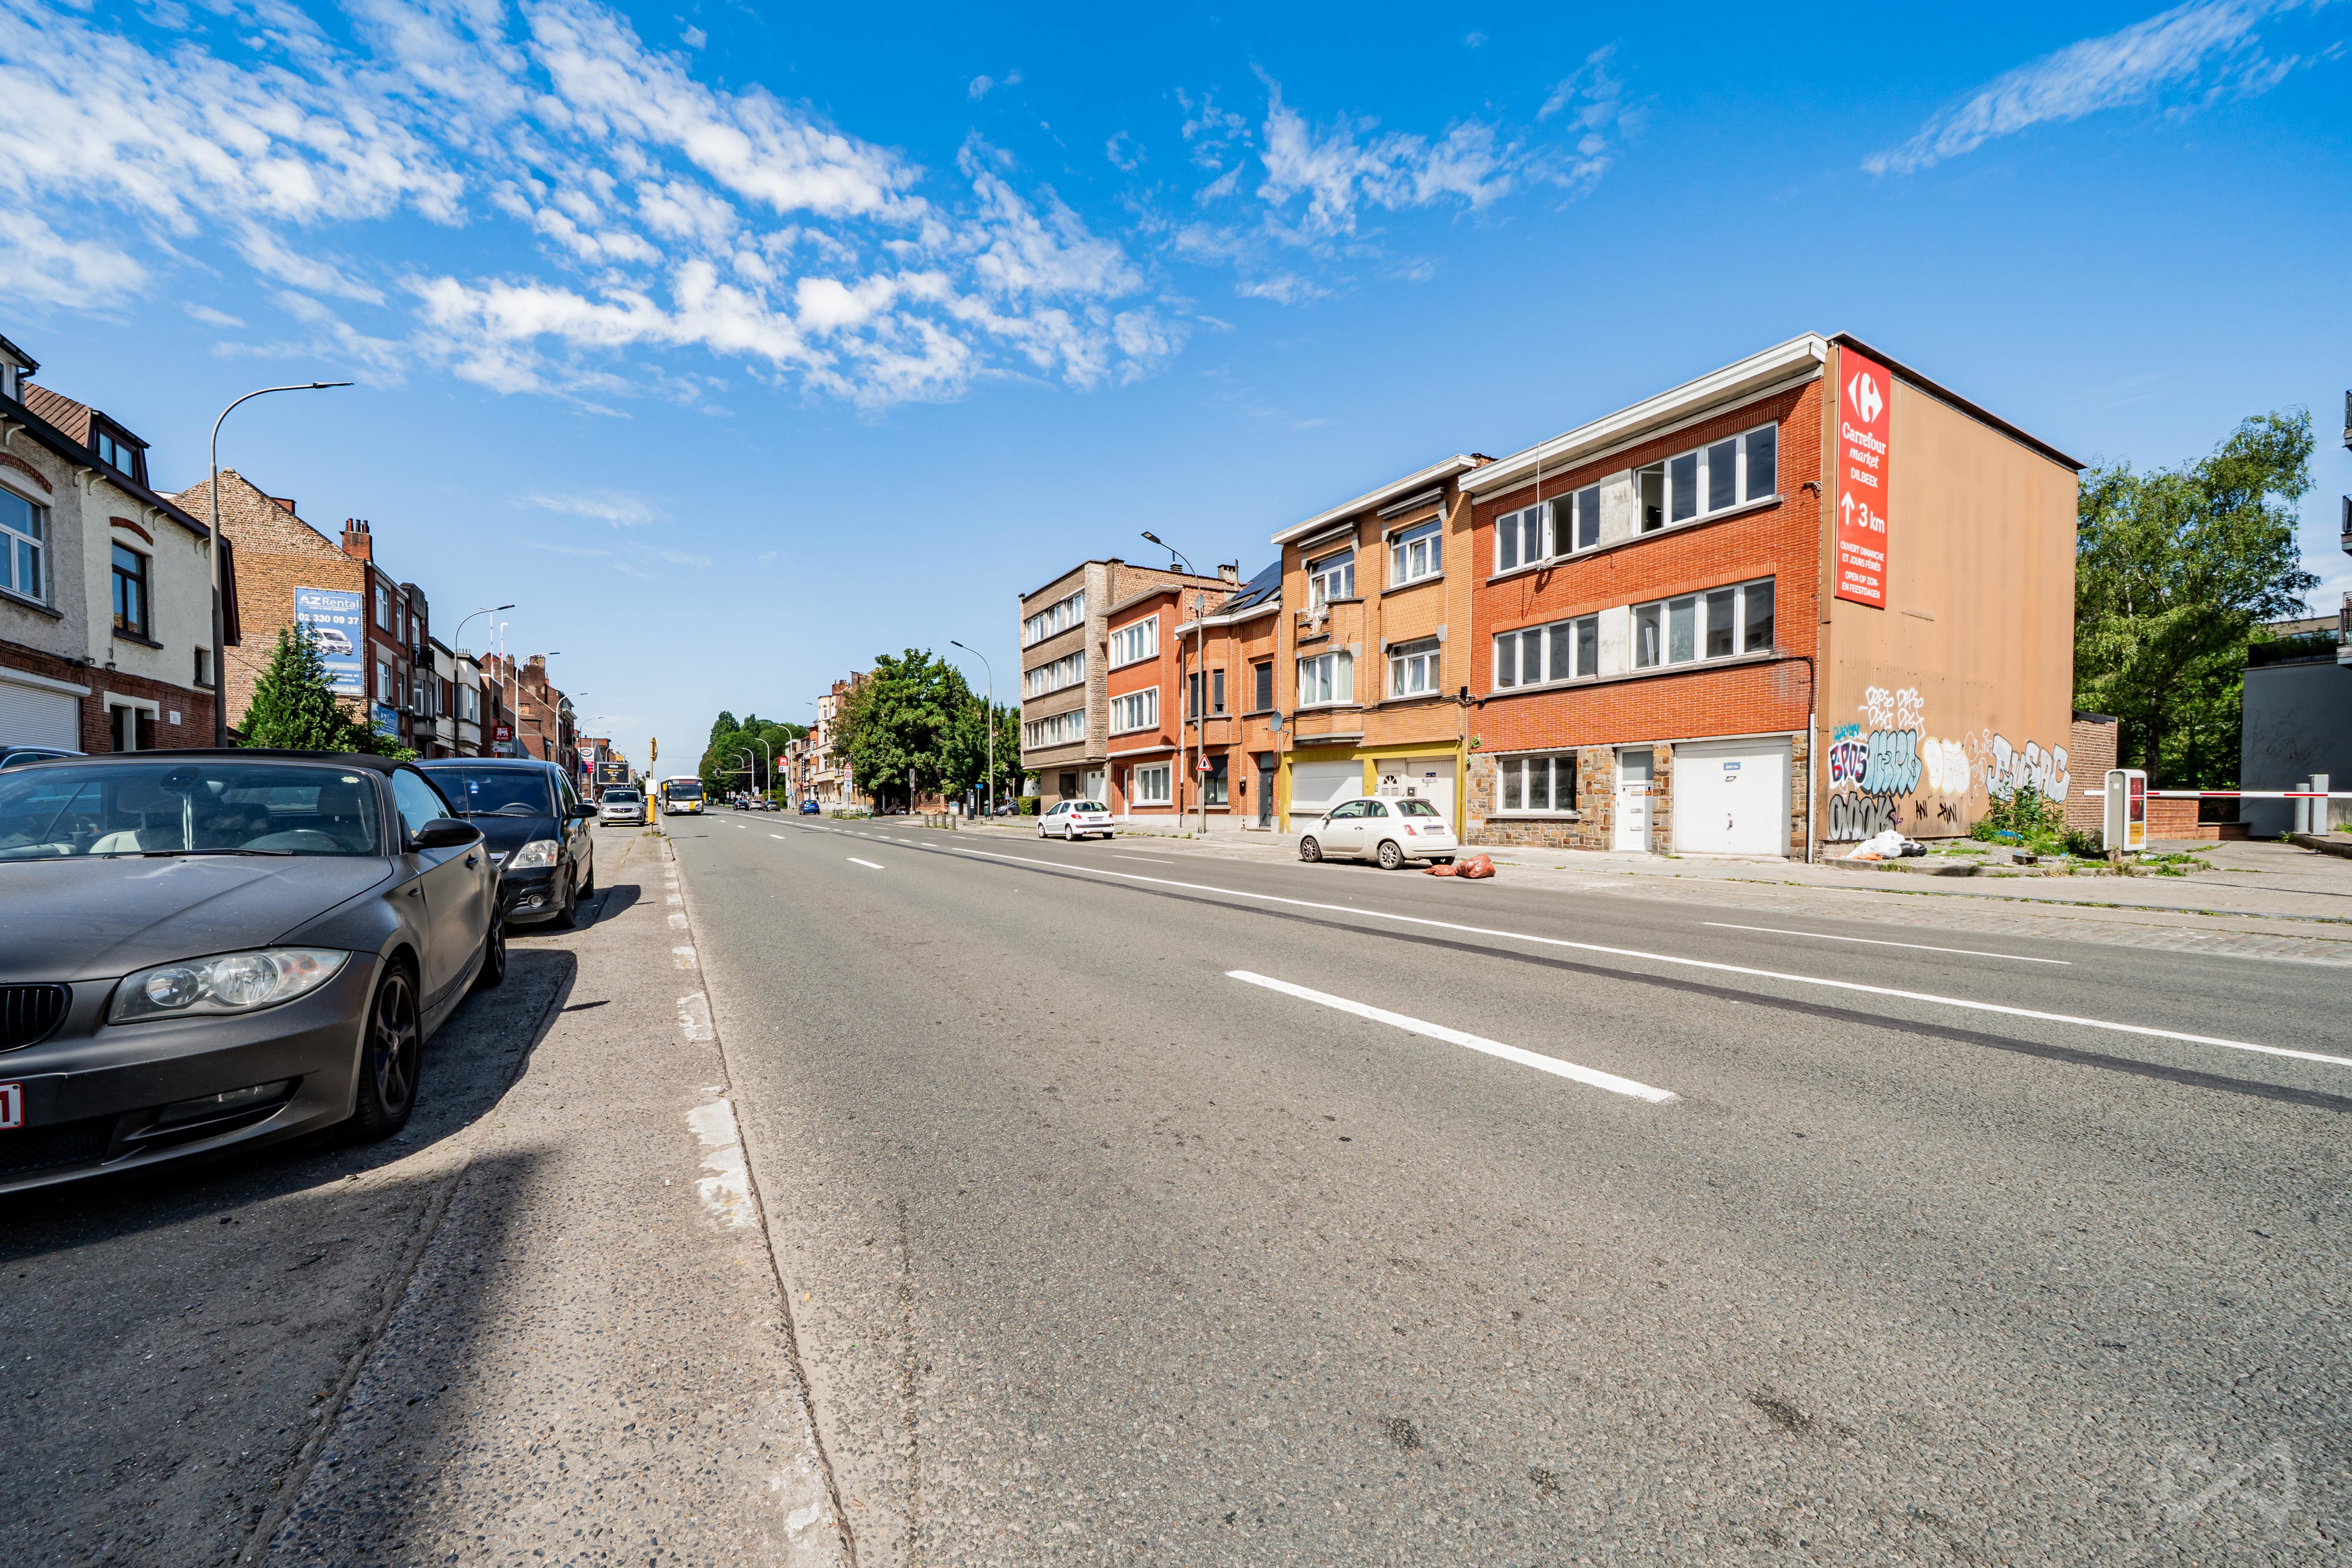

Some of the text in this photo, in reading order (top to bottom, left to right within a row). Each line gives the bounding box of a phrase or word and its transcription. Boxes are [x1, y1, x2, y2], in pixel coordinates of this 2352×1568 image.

[1843, 422, 1886, 455] Carrefour
[1849, 447, 1879, 469] market
[1851, 467, 1878, 488] DILBEEK
[1859, 503, 1885, 534] 3 km
[1840, 541, 1884, 561] OUVERT DIMANCHE
[1842, 553, 1881, 572] ET JOURS FÉRIÉS
[1845, 571, 1879, 587] OPEN OP ZON-
[1842, 582, 1880, 599] EN FEESTDAGEN
[313, 614, 330, 623] 330
[0, 1090, 10, 1123] 1
